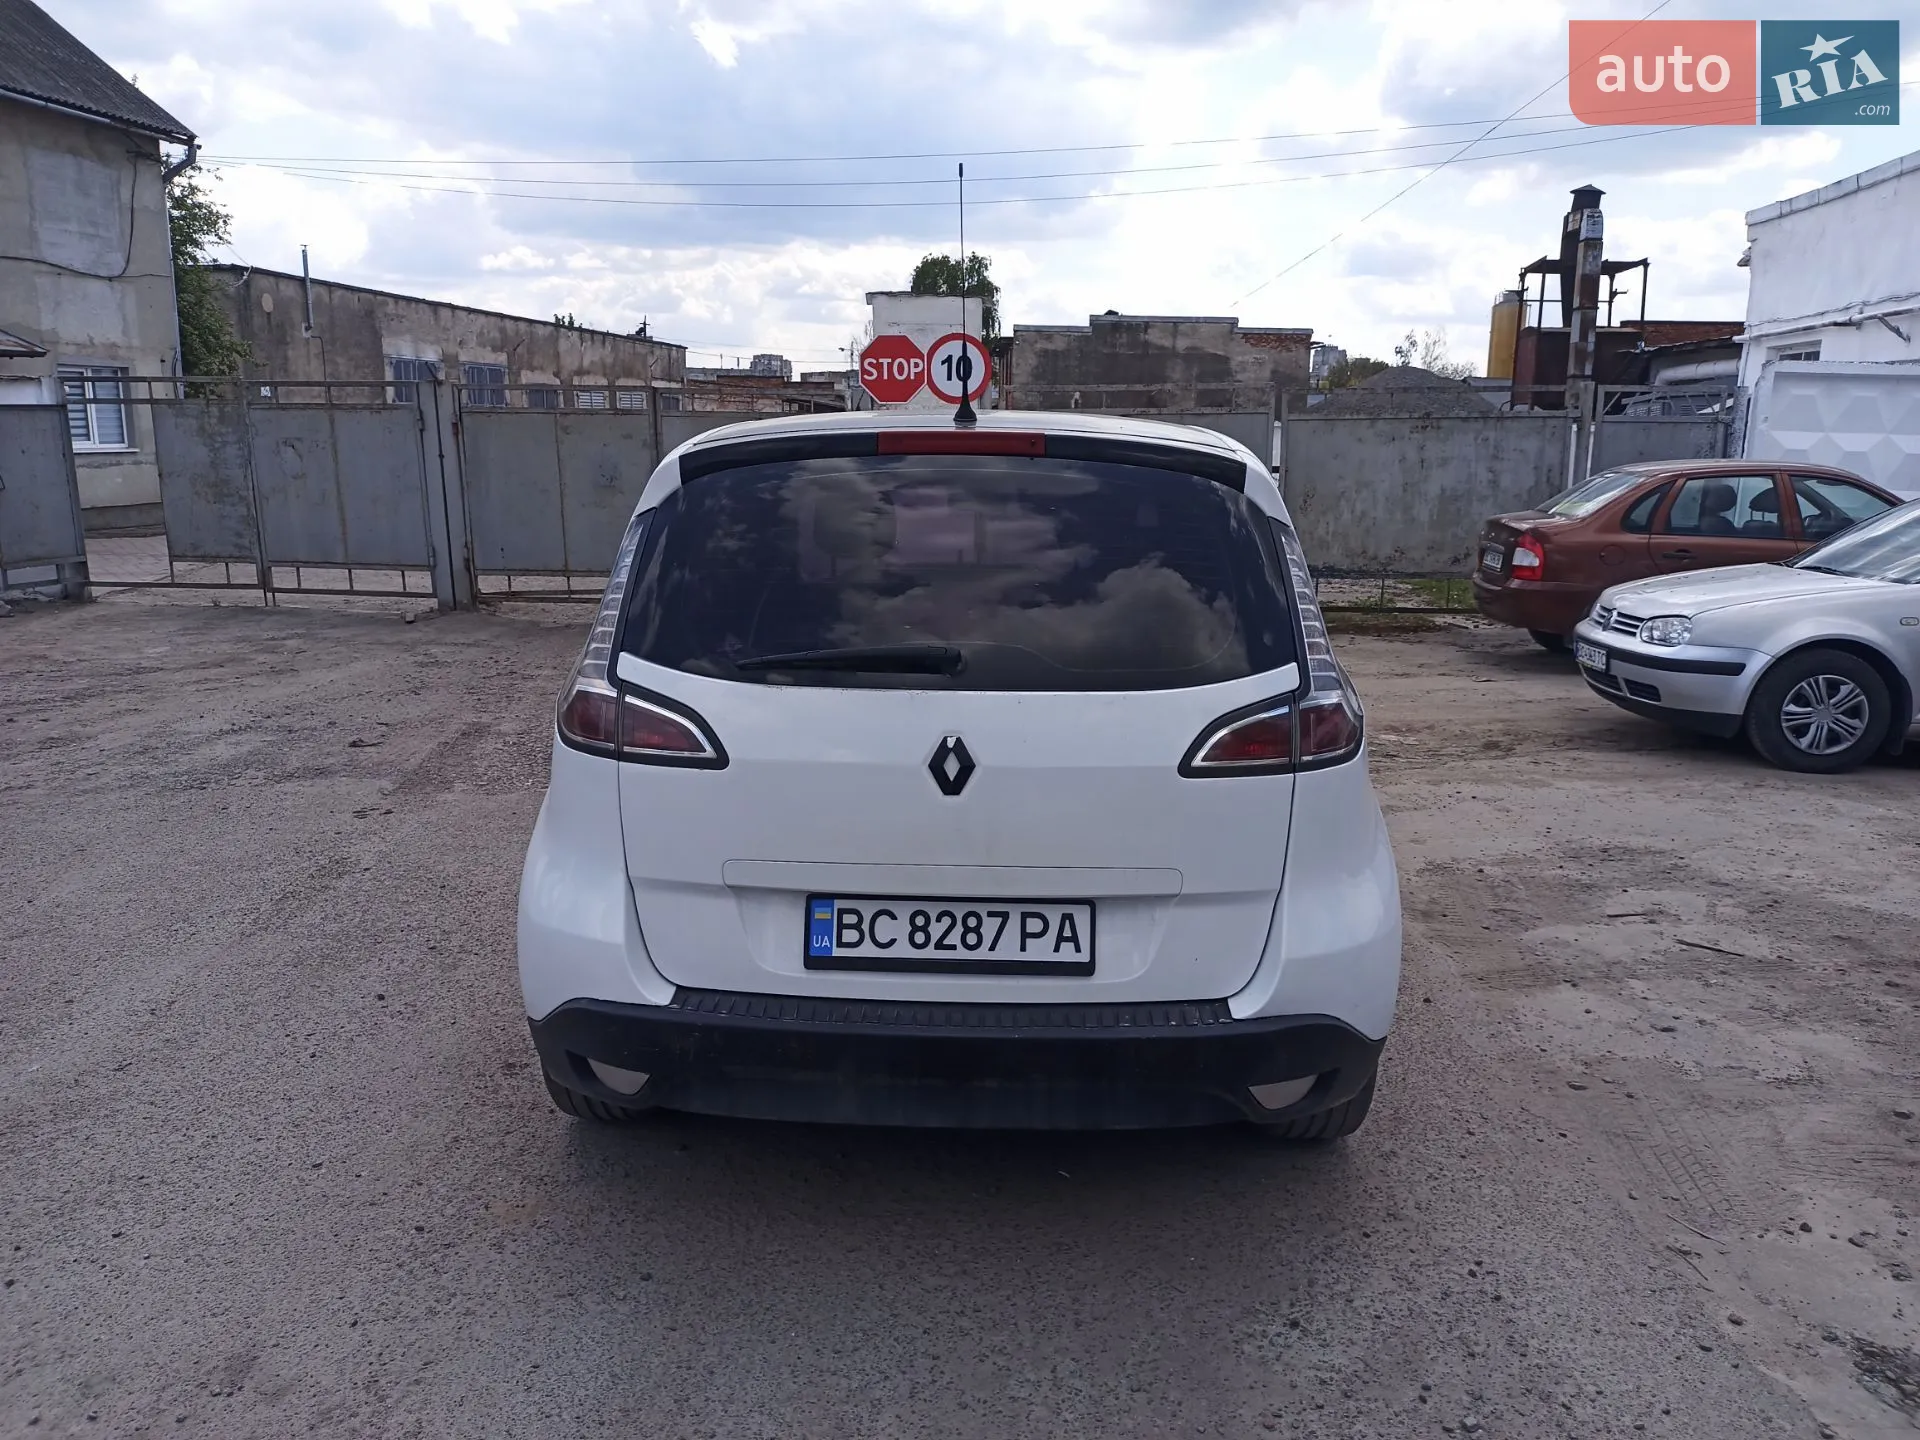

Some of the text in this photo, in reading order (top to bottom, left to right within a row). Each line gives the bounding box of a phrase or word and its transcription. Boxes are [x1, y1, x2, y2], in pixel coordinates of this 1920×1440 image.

[863, 357, 924, 381] STOP
[940, 354, 973, 382] 10
[813, 935, 831, 948] UA
[836, 908, 1082, 953] BC 8287 PA
